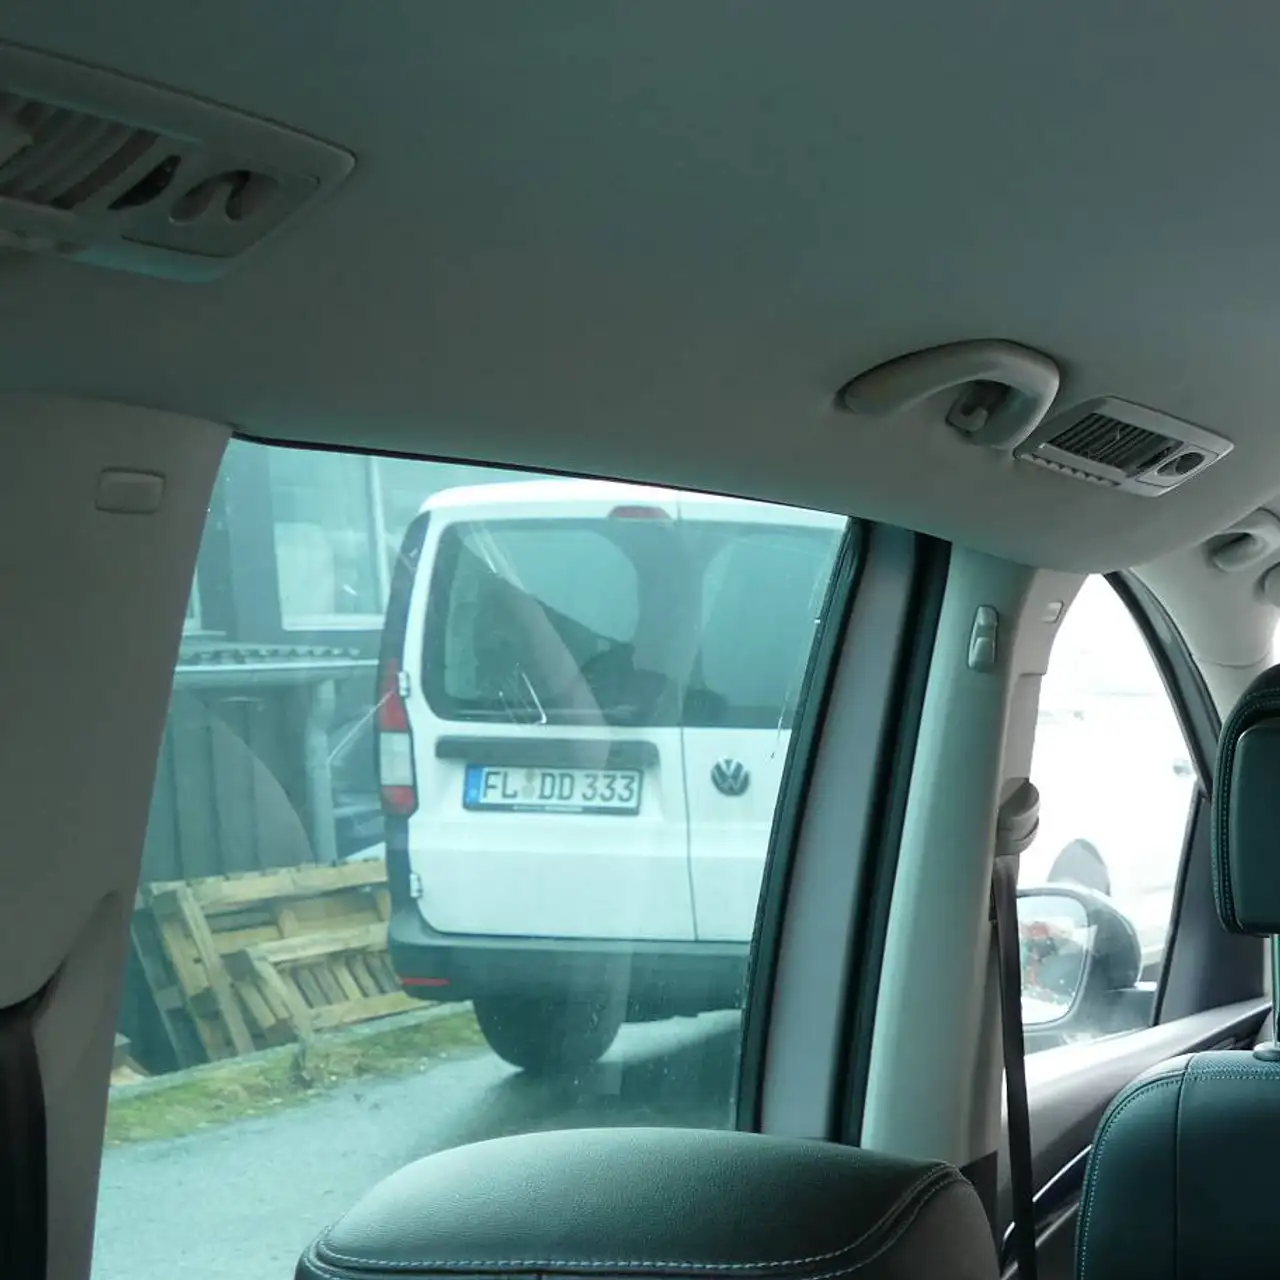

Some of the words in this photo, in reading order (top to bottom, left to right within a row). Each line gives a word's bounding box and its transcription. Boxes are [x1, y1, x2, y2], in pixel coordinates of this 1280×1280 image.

[484, 770, 518, 798] FL
[538, 772, 575, 801] DD
[582, 773, 635, 803] 333
